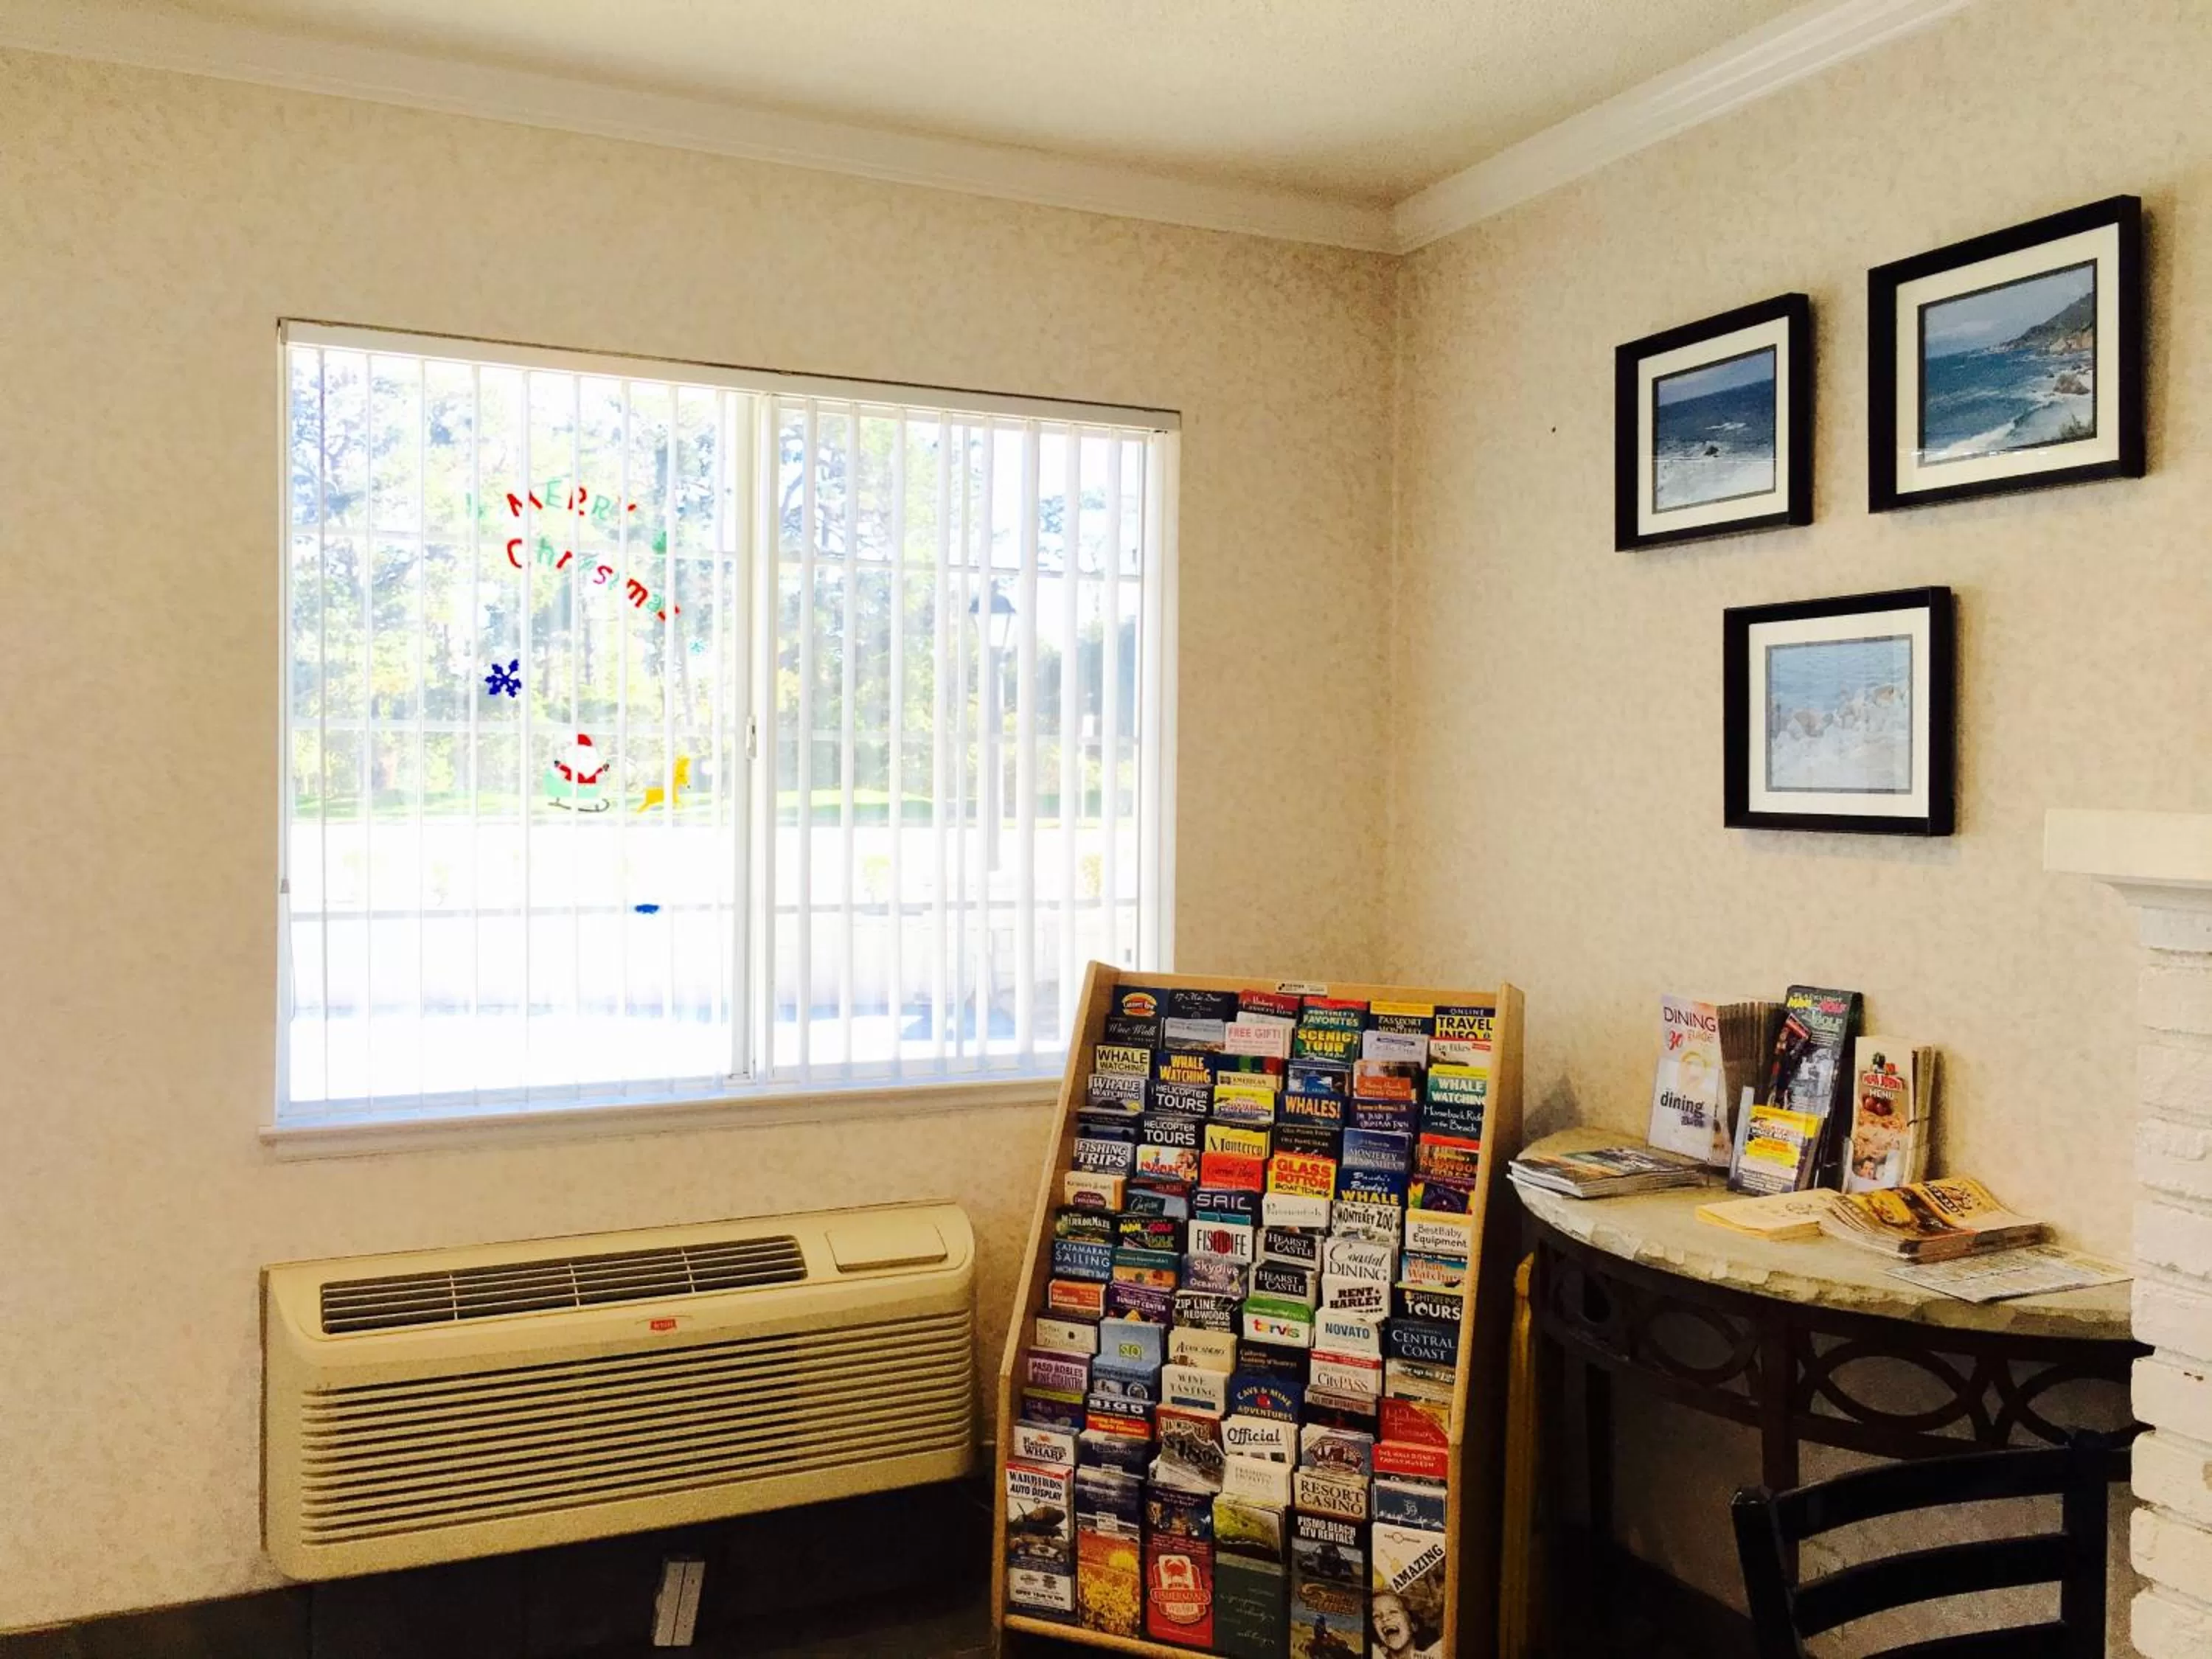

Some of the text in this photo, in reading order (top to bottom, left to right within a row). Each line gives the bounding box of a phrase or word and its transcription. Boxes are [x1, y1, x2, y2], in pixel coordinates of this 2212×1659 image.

[507, 479, 636, 521] MERR
[1450, 1008, 1484, 1016] ONLINE
[1663, 1006, 1717, 1032] DINING
[1304, 1015, 1359, 1027] FAVORITES
[1438, 1017, 1492, 1032] TRAVEL
[1228, 1026, 1251, 1038] FREE
[1297, 1028, 1352, 1043] SCENIC
[1306, 1040, 1345, 1053] TOUR
[1097, 1049, 1148, 1064] WHALE
[1170, 1054, 1204, 1069] WHALE
[1099, 1061, 1145, 1073] WATCHING
[1159, 1065, 1211, 1085] WATCHING
[1092, 1076, 1140, 1093] WHALE
[1155, 1084, 1208, 1099] HELICOPTER
[1438, 1078, 1484, 1091] WHALE
[1092, 1088, 1140, 1099] WATCHING
[1155, 1093, 1208, 1113] TOURS
[1284, 1094, 1341, 1119] WHALES!
[1660, 1091, 1705, 1119] dining
[1144, 1120, 1195, 1132] HELICOPTER
[1449, 1119, 1477, 1133] Beach
[1144, 1129, 1195, 1145] TOURS
[1078, 1141, 1127, 1155] FISHING
[1077, 1152, 1127, 1168] TRIPS
[1276, 1158, 1332, 1178] GLASS
[1276, 1172, 1331, 1190] BOTTOM
[1341, 1190, 1399, 1206] WHALE
[1267, 1232, 1310, 1248] HEARST
[1412, 1233, 1467, 1250] Equipment
[1054, 1242, 1111, 1257] CATAMARAN
[1274, 1242, 1314, 1256] CASTLE
[1054, 1252, 1111, 1268] SAILING
[1193, 1259, 1239, 1276] Skydive
[1258, 1270, 1299, 1284] HEARST
[1329, 1260, 1388, 1281] DINING
[1265, 1281, 1305, 1294] CASTLE
[1338, 1287, 1374, 1299] RENT
[1175, 1298, 1216, 1310] ZIP LINE
[1329, 1295, 1382, 1310] HARLEY
[1405, 1299, 1461, 1321] TOURS
[1183, 1310, 1231, 1321] REDWOODS
[1325, 1322, 1371, 1340] NOVATO
[1391, 1329, 1456, 1349] CENTRAL
[1402, 1343, 1447, 1361] COAST
[1317, 1371, 1369, 1391] CityPASS
[1169, 1382, 1217, 1397] TASTING
[1226, 1427, 1282, 1446] Official
[1024, 1445, 1065, 1463] WHARF
[1009, 1471, 1062, 1490] WARBIRDS
[1009, 1483, 1062, 1501] AUTO DISPLAY
[1300, 1479, 1364, 1503] RESORT
[1300, 1492, 1363, 1515] CASINO
[1297, 1515, 1356, 1537] PISMO BEACH
[1300, 1528, 1355, 1546] ATV RENTALS
[1391, 1543, 1445, 1590] AMAZING
